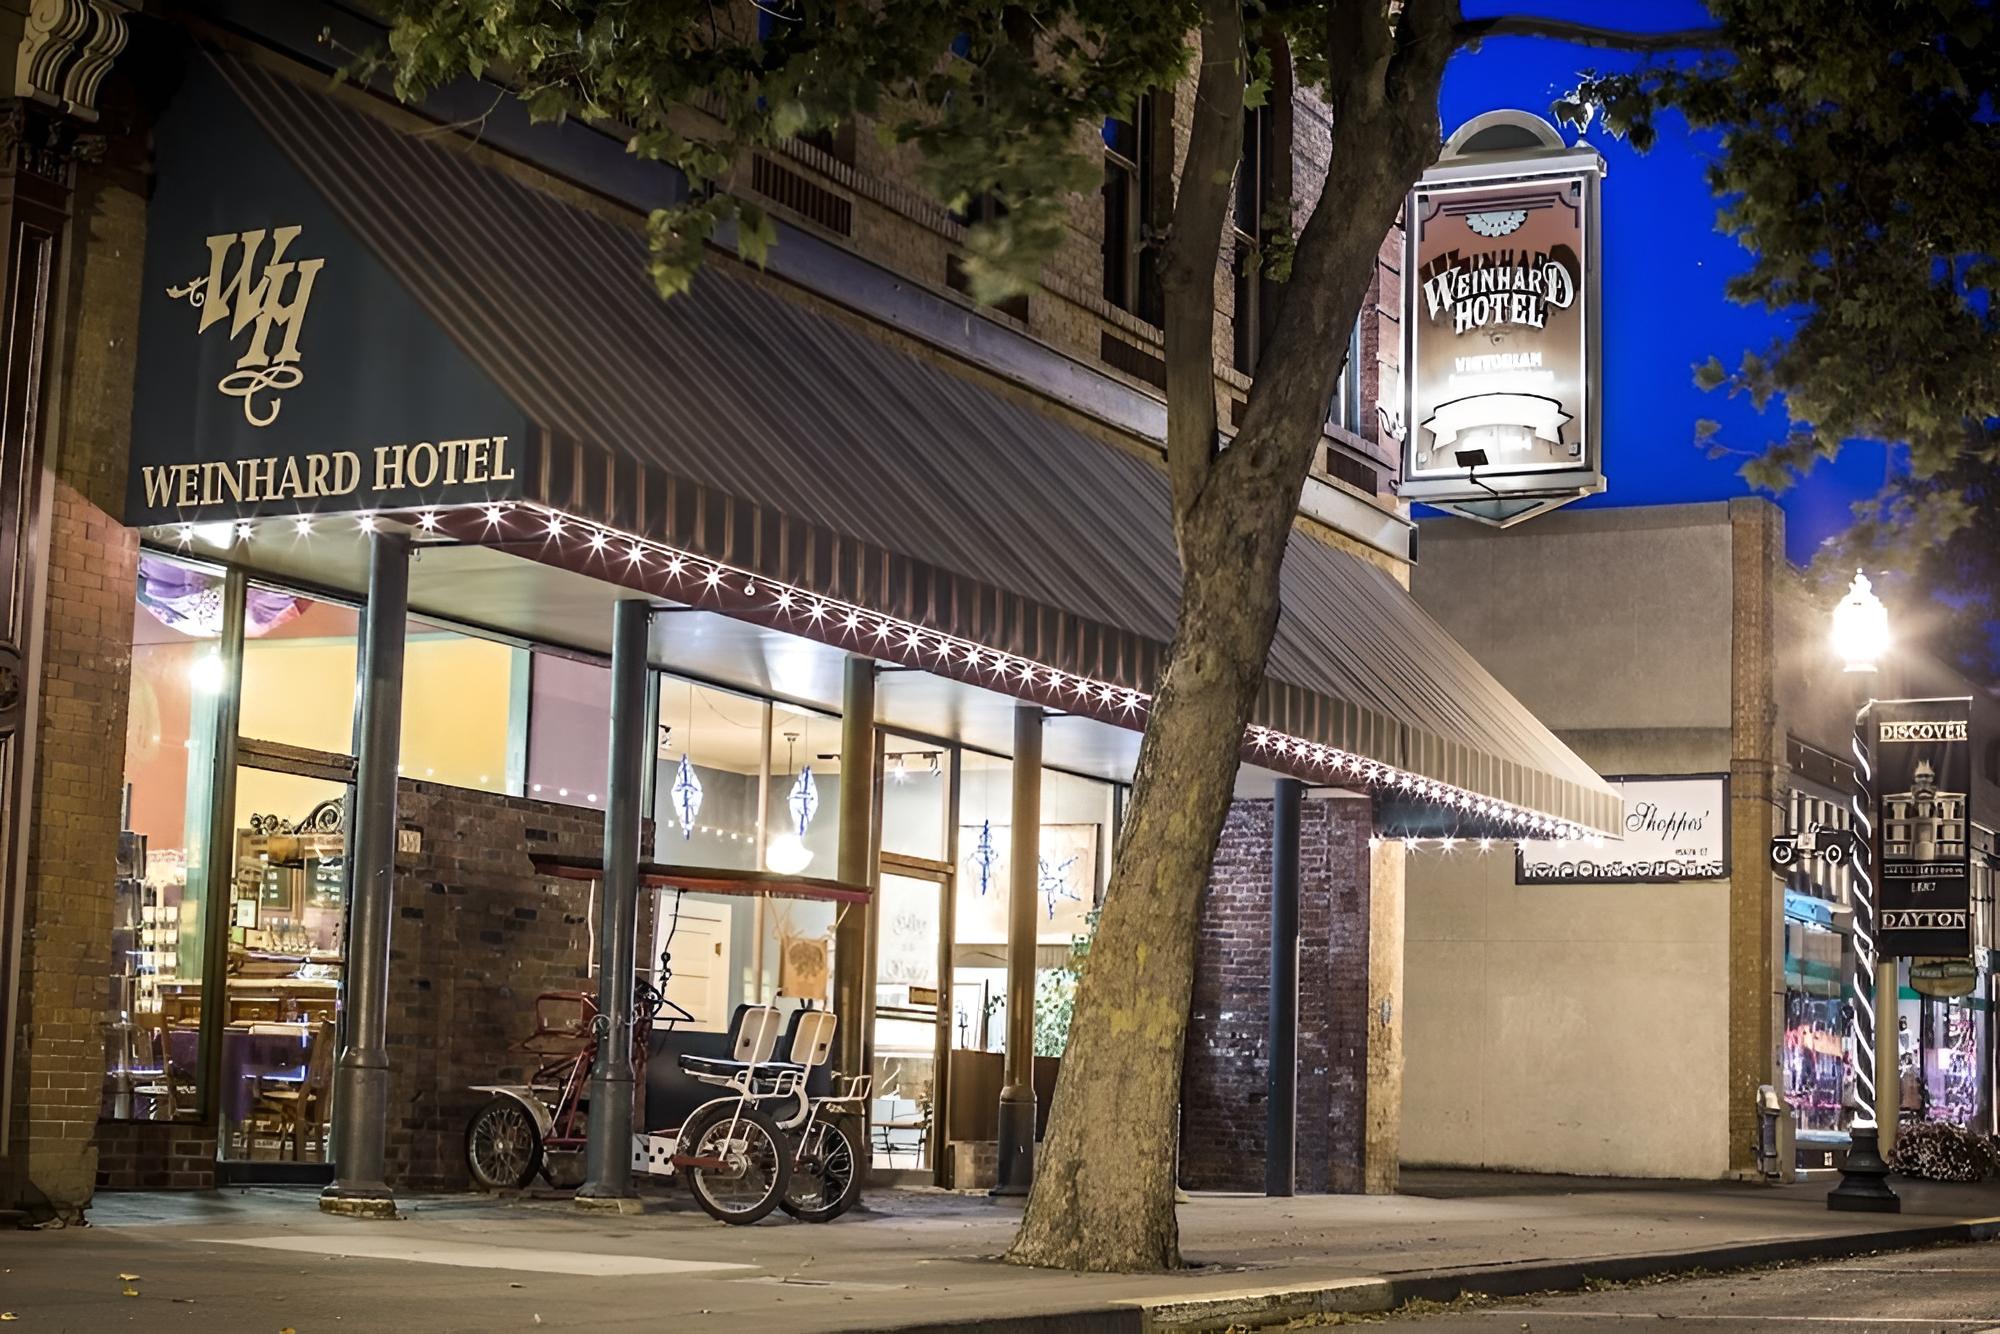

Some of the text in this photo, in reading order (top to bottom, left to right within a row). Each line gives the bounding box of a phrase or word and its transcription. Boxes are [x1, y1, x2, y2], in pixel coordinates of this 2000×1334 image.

[1423, 261, 1574, 321] WEINHARD
[1456, 293, 1544, 335] HOTEL
[142, 436, 515, 509] WEINHARD HOTEL
[1880, 723, 1967, 740] DISCOVER
[1882, 911, 1966, 928] DAYTON
